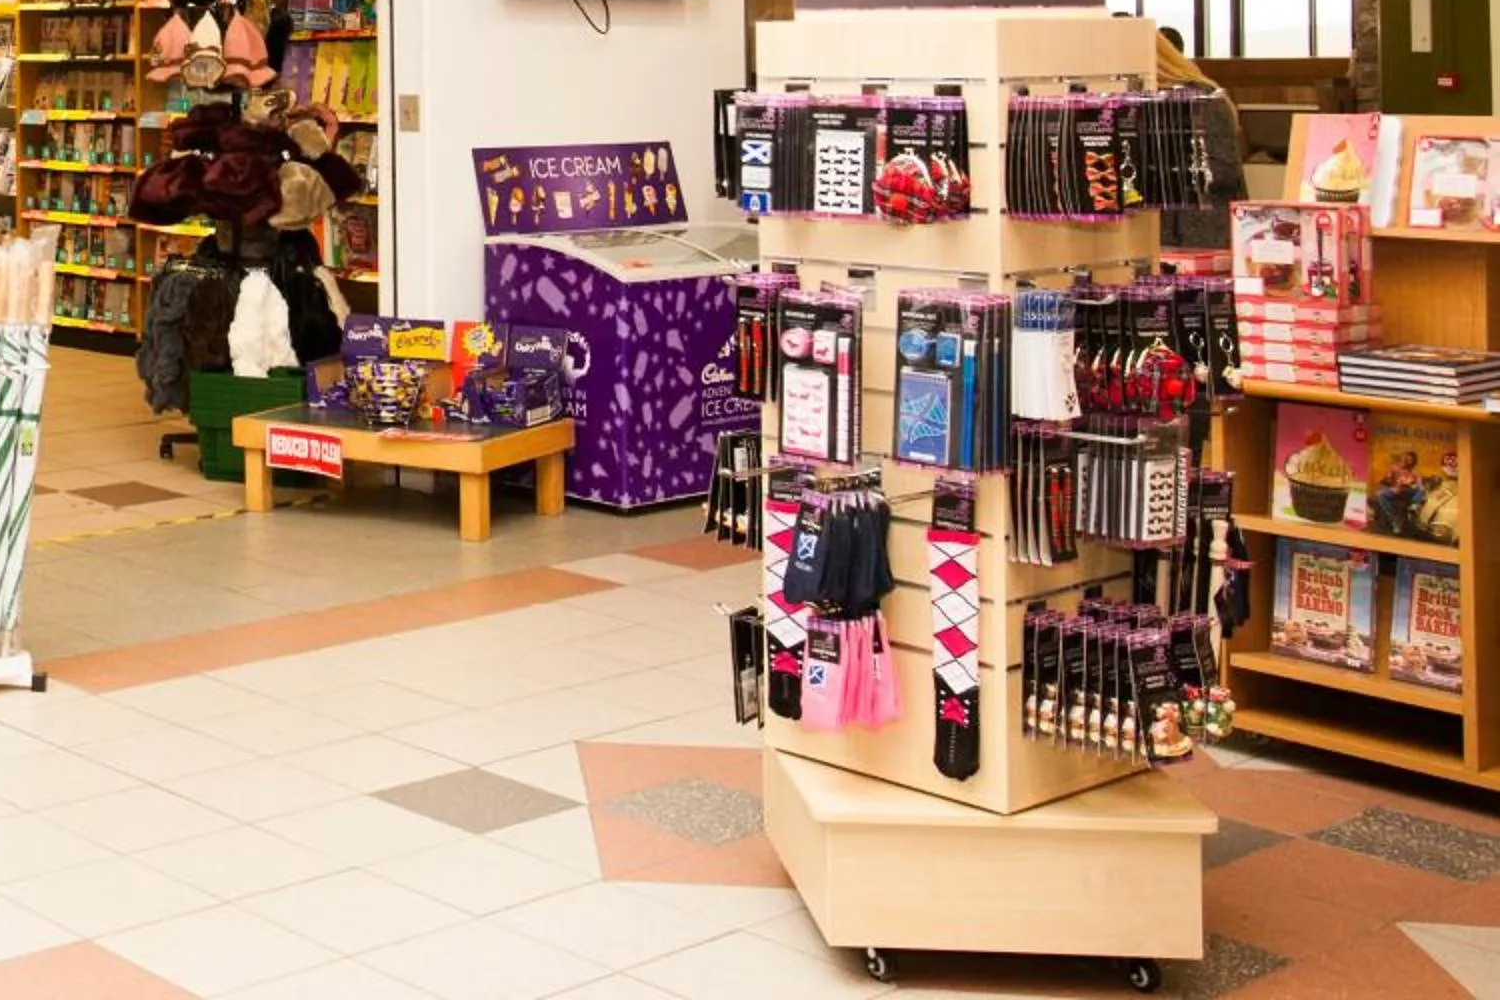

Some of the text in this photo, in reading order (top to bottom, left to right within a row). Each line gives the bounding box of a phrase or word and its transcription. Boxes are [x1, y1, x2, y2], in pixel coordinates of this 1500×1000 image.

[529, 155, 623, 178] ICE CREAM
[701, 402, 722, 417] ICE
